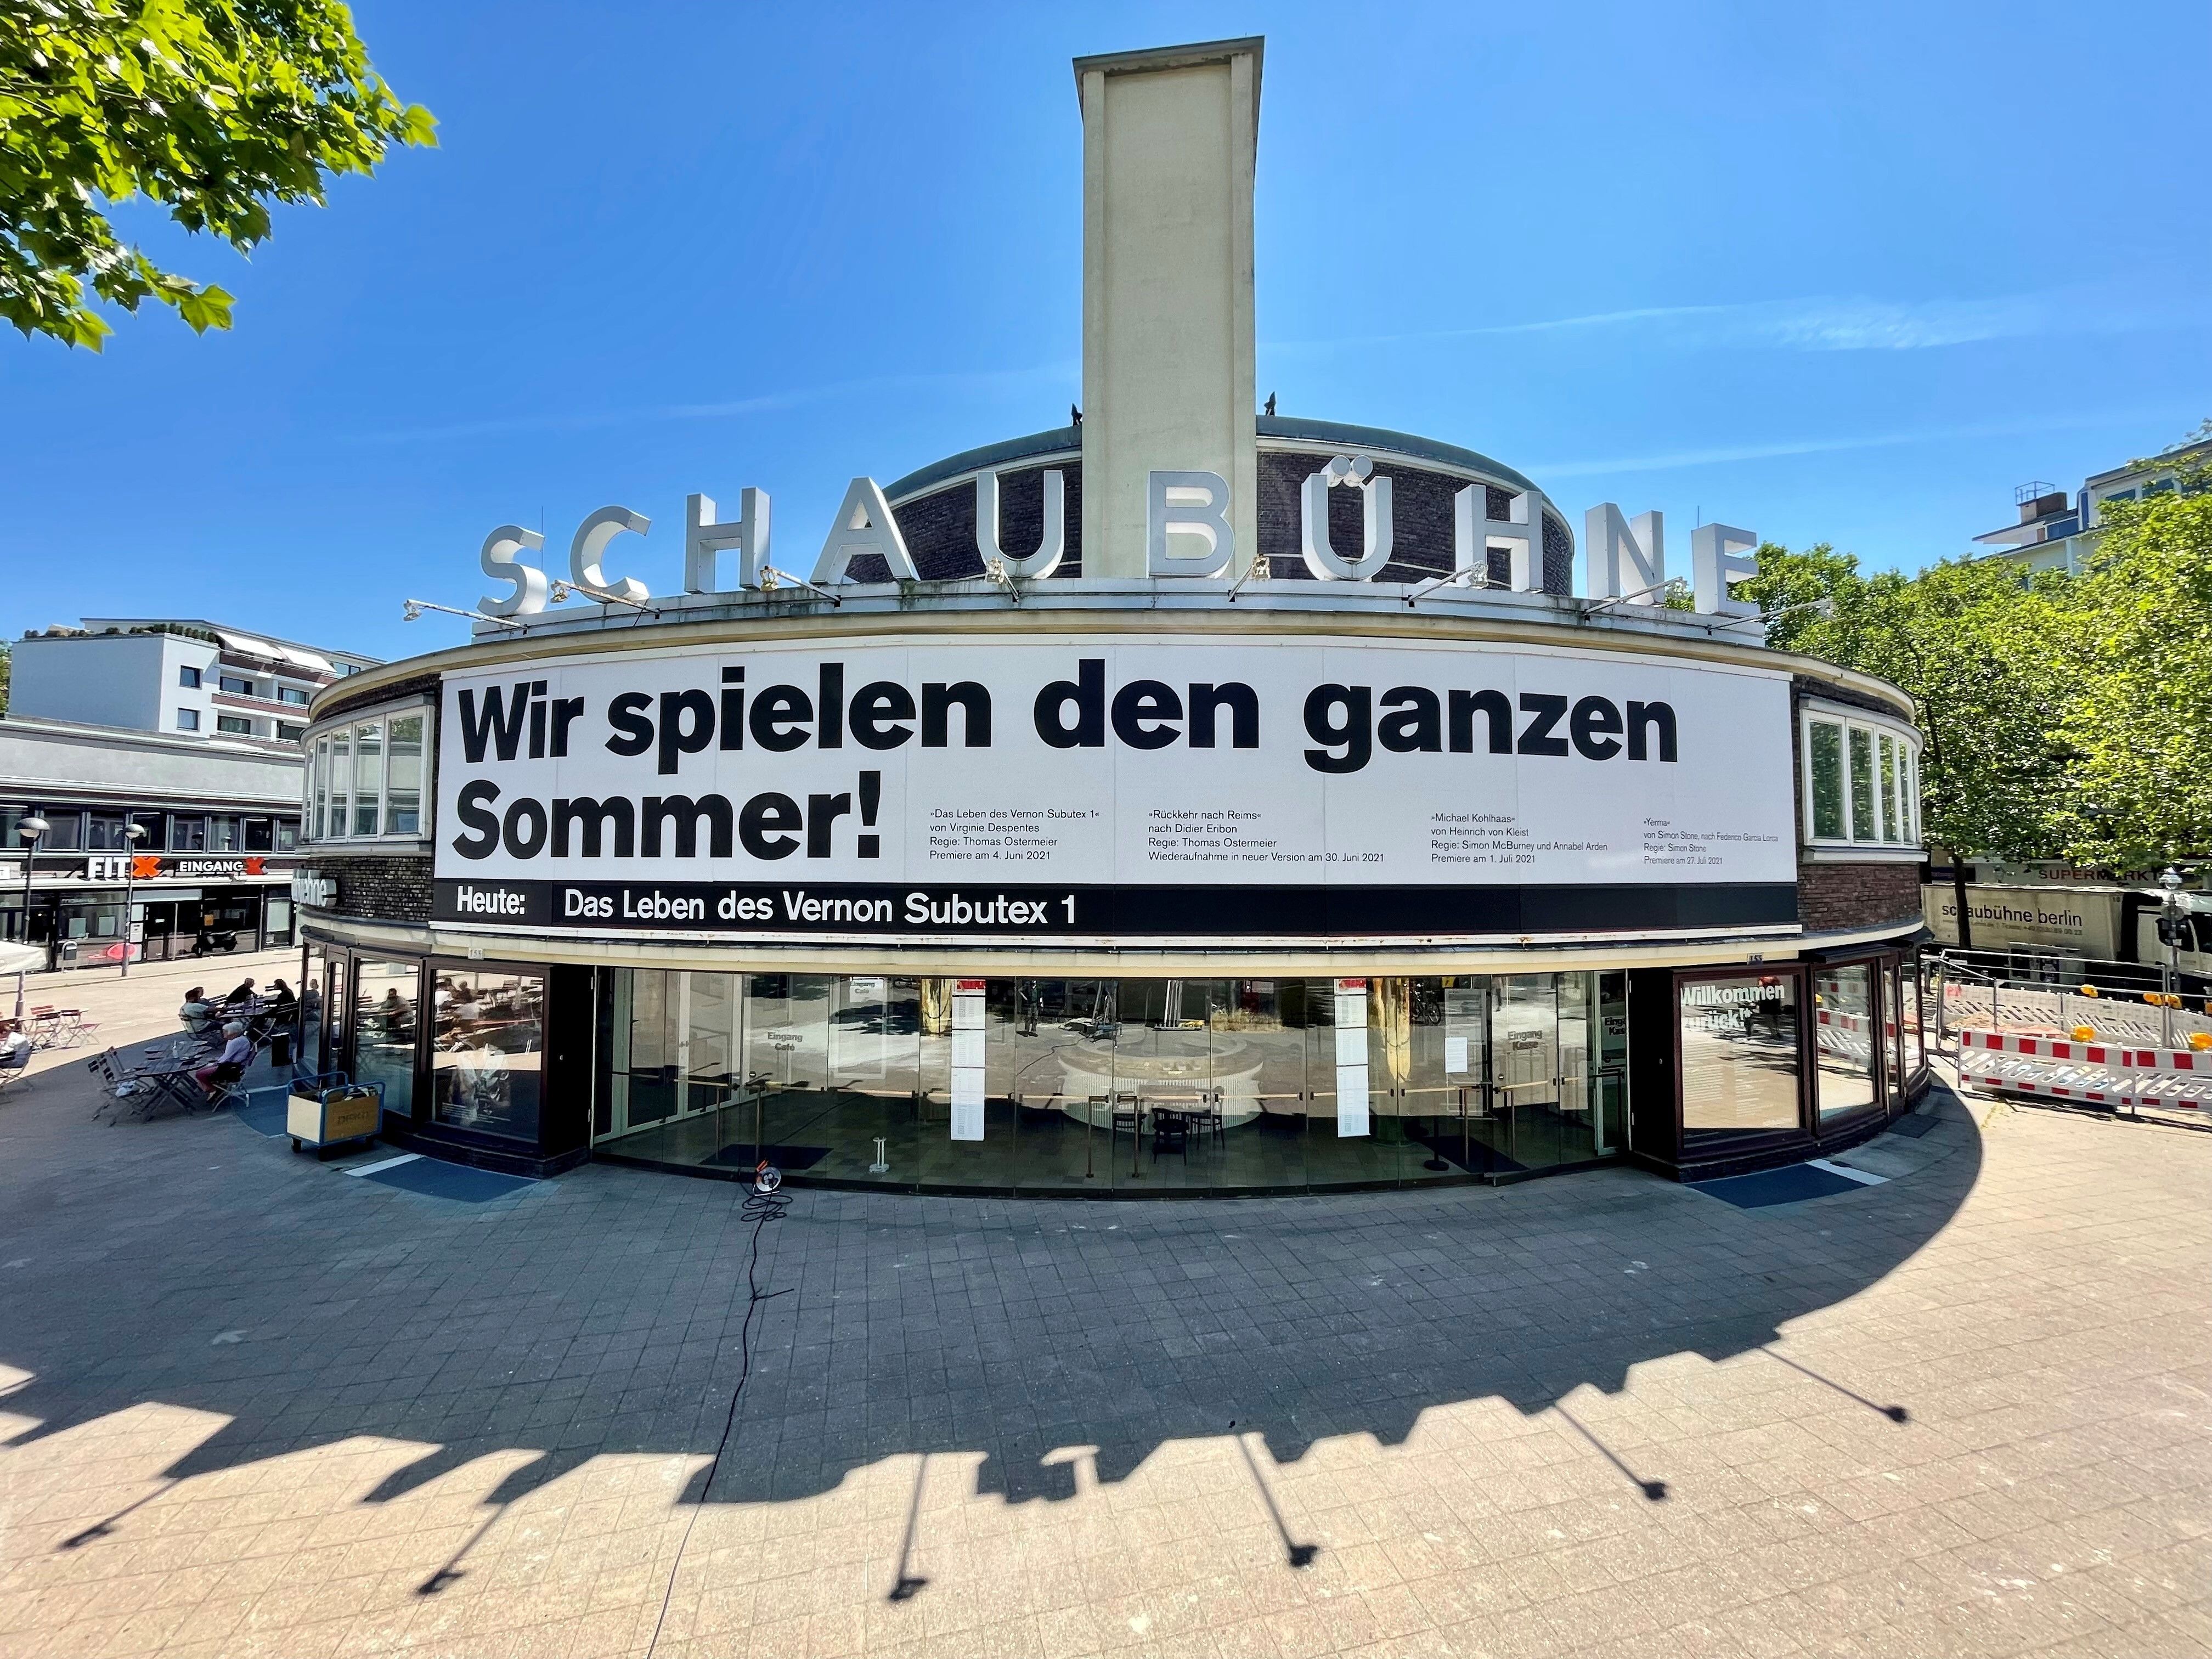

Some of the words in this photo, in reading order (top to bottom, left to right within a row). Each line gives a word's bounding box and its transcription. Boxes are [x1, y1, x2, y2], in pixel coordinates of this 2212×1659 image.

[477, 455, 1762, 618] SCHAUBÜHNE
[458, 680, 584, 763] Wir
[605, 663, 991, 775] spielen
[1034, 659, 1259, 750] den
[1304, 684, 1677, 774] ganzen
[452, 771, 881, 860] Sommer!
[957, 809, 986, 818] Leben
[990, 809, 1007, 818] des
[1011, 809, 1043, 818] Vernon
[1047, 809, 1086, 818] Subutex
[1201, 810, 1223, 819] nach
[950, 823, 984, 834] Virginie
[989, 823, 1039, 834] Despentes
[1149, 824, 1171, 832] nach
[1176, 824, 1203, 832] Didier
[1207, 824, 1237, 833] Eribon
[1450, 827, 1485, 836] Heinrich
[1506, 827, 1528, 836] Kleist
[1658, 831, 1679, 839] Simon
[1680, 831, 1699, 840] Stone,
[930, 837, 960, 848] Regie:
[963, 837, 1001, 845] Thomas
[1005, 837, 1057, 846] Ostermeier
[1149, 838, 1178, 849] Regie:
[1182, 838, 1220, 847] Thomas
[1224, 838, 1277, 847] Ostermeier
[1432, 840, 1459, 851] Regie:
[1462, 840, 1489, 849] Simon
[1493, 841, 1534, 852] McBurney
[1537, 842, 1551, 850] und
[1554, 842, 1583, 850] Annabel
[1586, 842, 1607, 850] Arden
[1644, 843, 1666, 854] Regie:
[1668, 843, 1687, 851] Simon
[1689, 844, 1706, 852] Stone
[930, 850, 972, 859] Premiere
[1005, 851, 1023, 859] Juni
[1027, 851, 1049, 860] 2021
[1149, 851, 1228, 860] Wiederaufnahme
[1232, 852, 1238, 860] in
[1271, 853, 1305, 861] Version
[1325, 853, 1339, 861] 30.
[1342, 853, 1359, 861] Juni
[1362, 853, 1383, 861] 2021
[1432, 854, 1470, 862] Premiere
[1499, 854, 1513, 862] Juli
[1516, 855, 1534, 863] 2021
[1644, 856, 1674, 864] Premiere
[179, 861, 244, 872] EINGANG
[2039, 870, 2160, 881] SUPERMRKT
[457, 886, 525, 914] Heute:
[565, 889, 613, 917] Das
[624, 890, 704, 919] Leben
[718, 890, 773, 919] des
[783, 891, 892, 922] Vernon
[905, 893, 1048, 924] Subutex
[1062, 895, 1074, 923] 1
[1942, 904, 2033, 922] scaubühne
[2038, 908, 2083, 926] berlin
[1681, 985, 1785, 1006] Willkommen
[768, 1032, 803, 1042] Eingang
[1508, 1030, 1542, 1041] Eingang
[1513, 1041, 1538, 1051] Kasse
